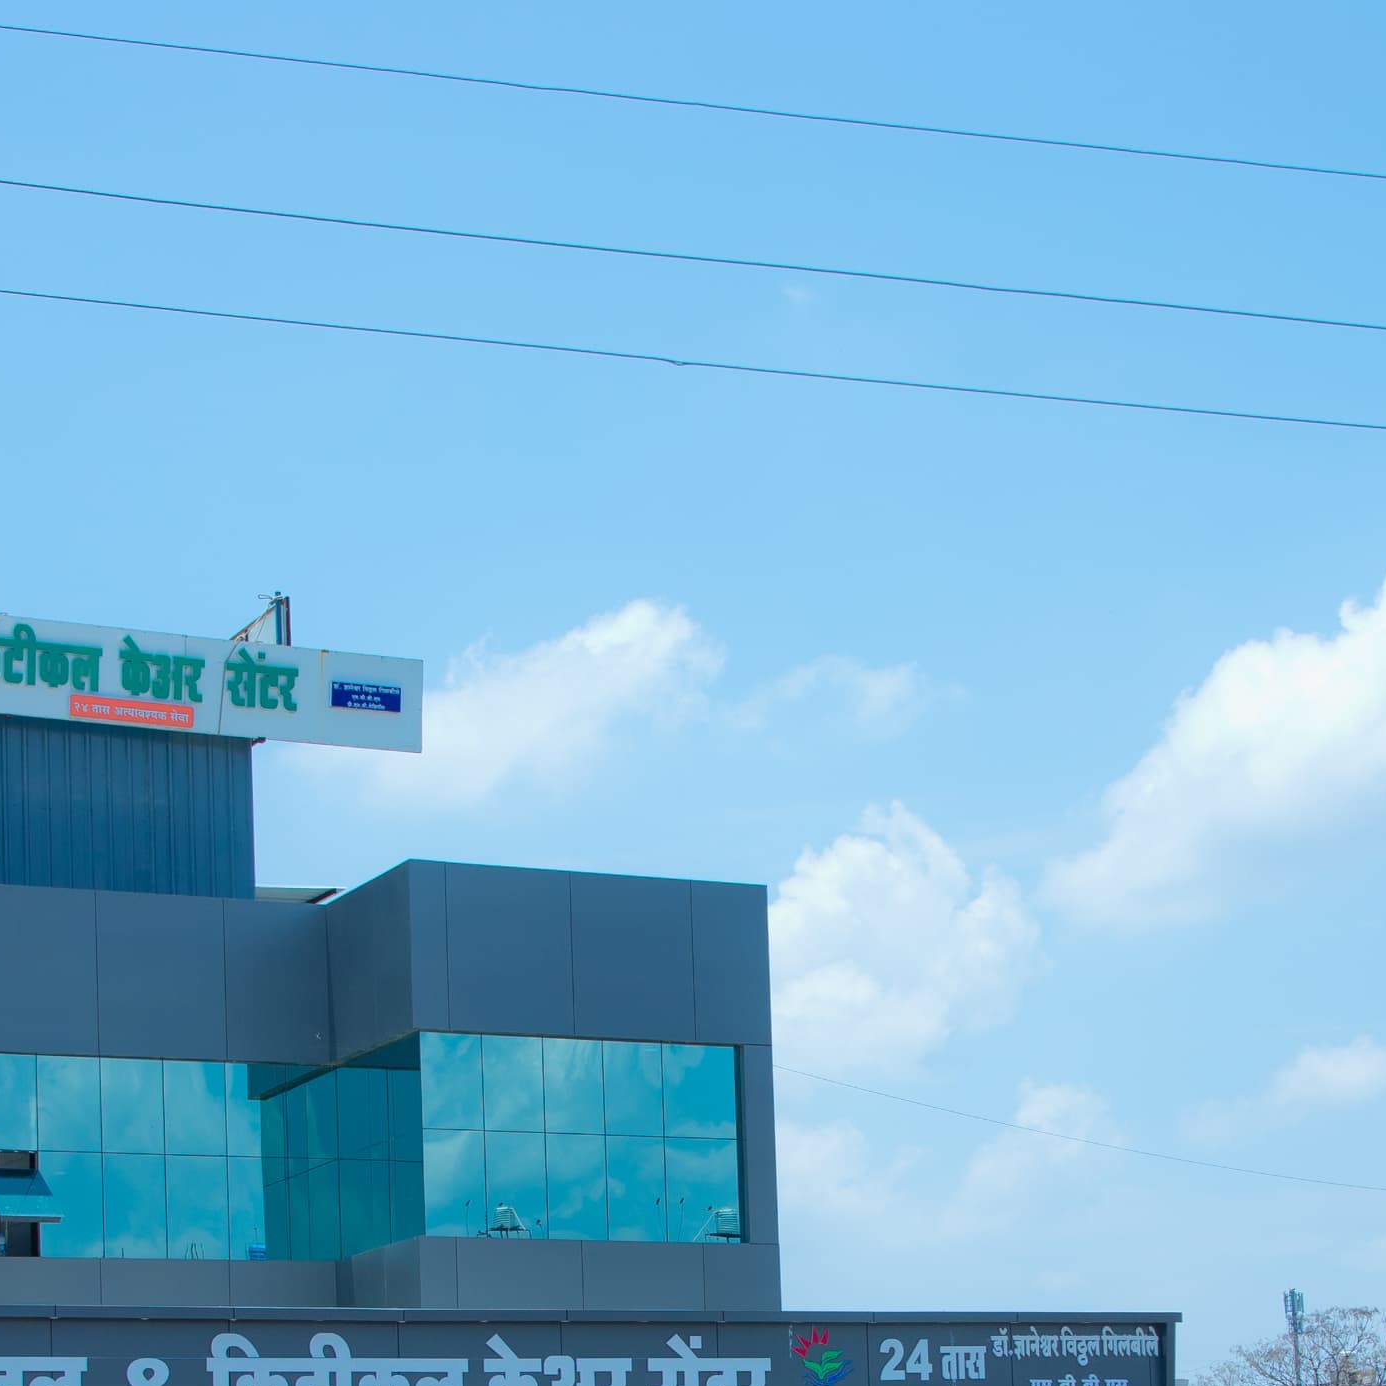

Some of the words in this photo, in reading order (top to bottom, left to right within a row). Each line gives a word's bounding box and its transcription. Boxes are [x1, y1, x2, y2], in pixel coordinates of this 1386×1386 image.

[119, 635, 205, 703] केअर
[226, 648, 299, 713] सेंटर
[879, 1338, 933, 1382] 24
[939, 1344, 987, 1382] तास
